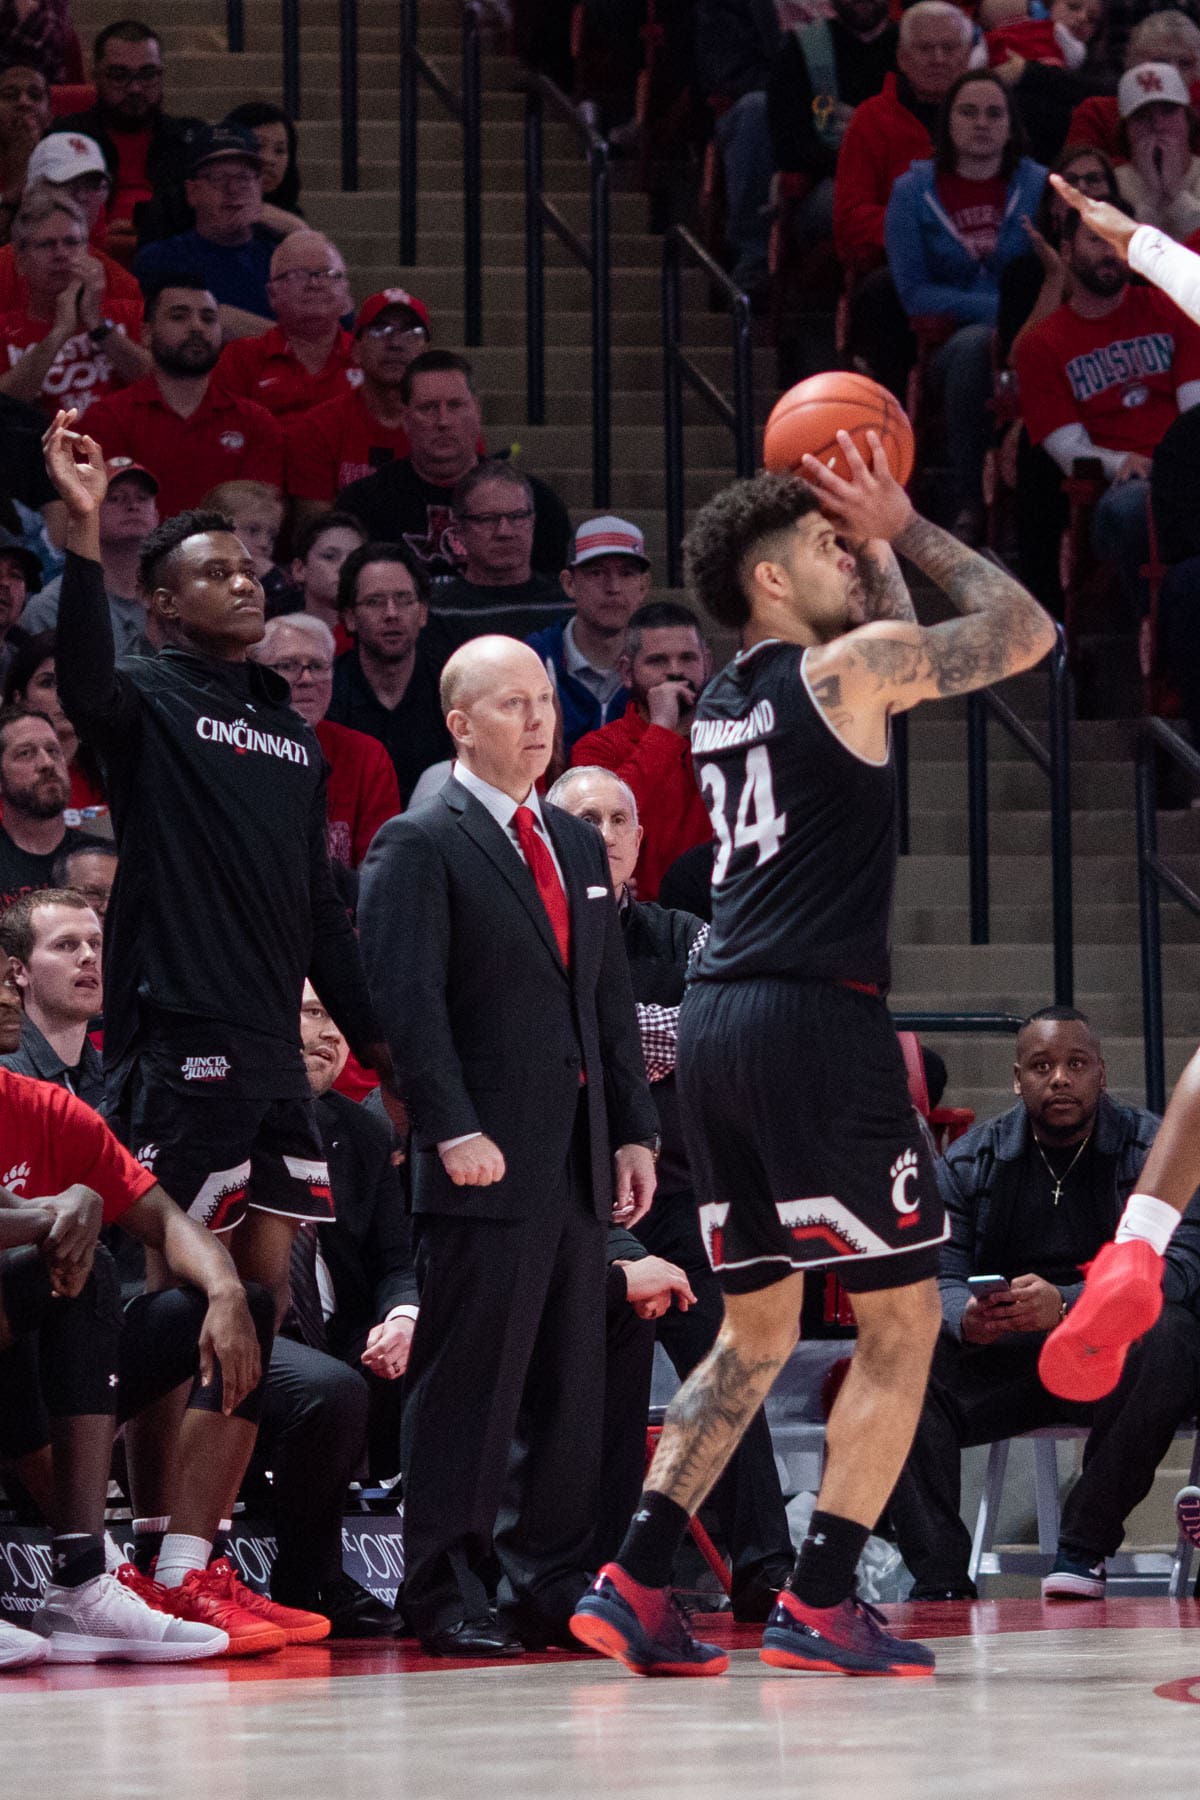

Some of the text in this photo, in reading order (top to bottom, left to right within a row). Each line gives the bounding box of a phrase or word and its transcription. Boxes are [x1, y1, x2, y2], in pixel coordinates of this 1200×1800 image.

[1065, 332, 1175, 402] HOUSTON
[196, 716, 309, 767] CINCINNATI
[699, 744, 786, 885] 34
[181, 1056, 231, 1072] JUNCTA
[184, 1066, 227, 1080] JUVANT
